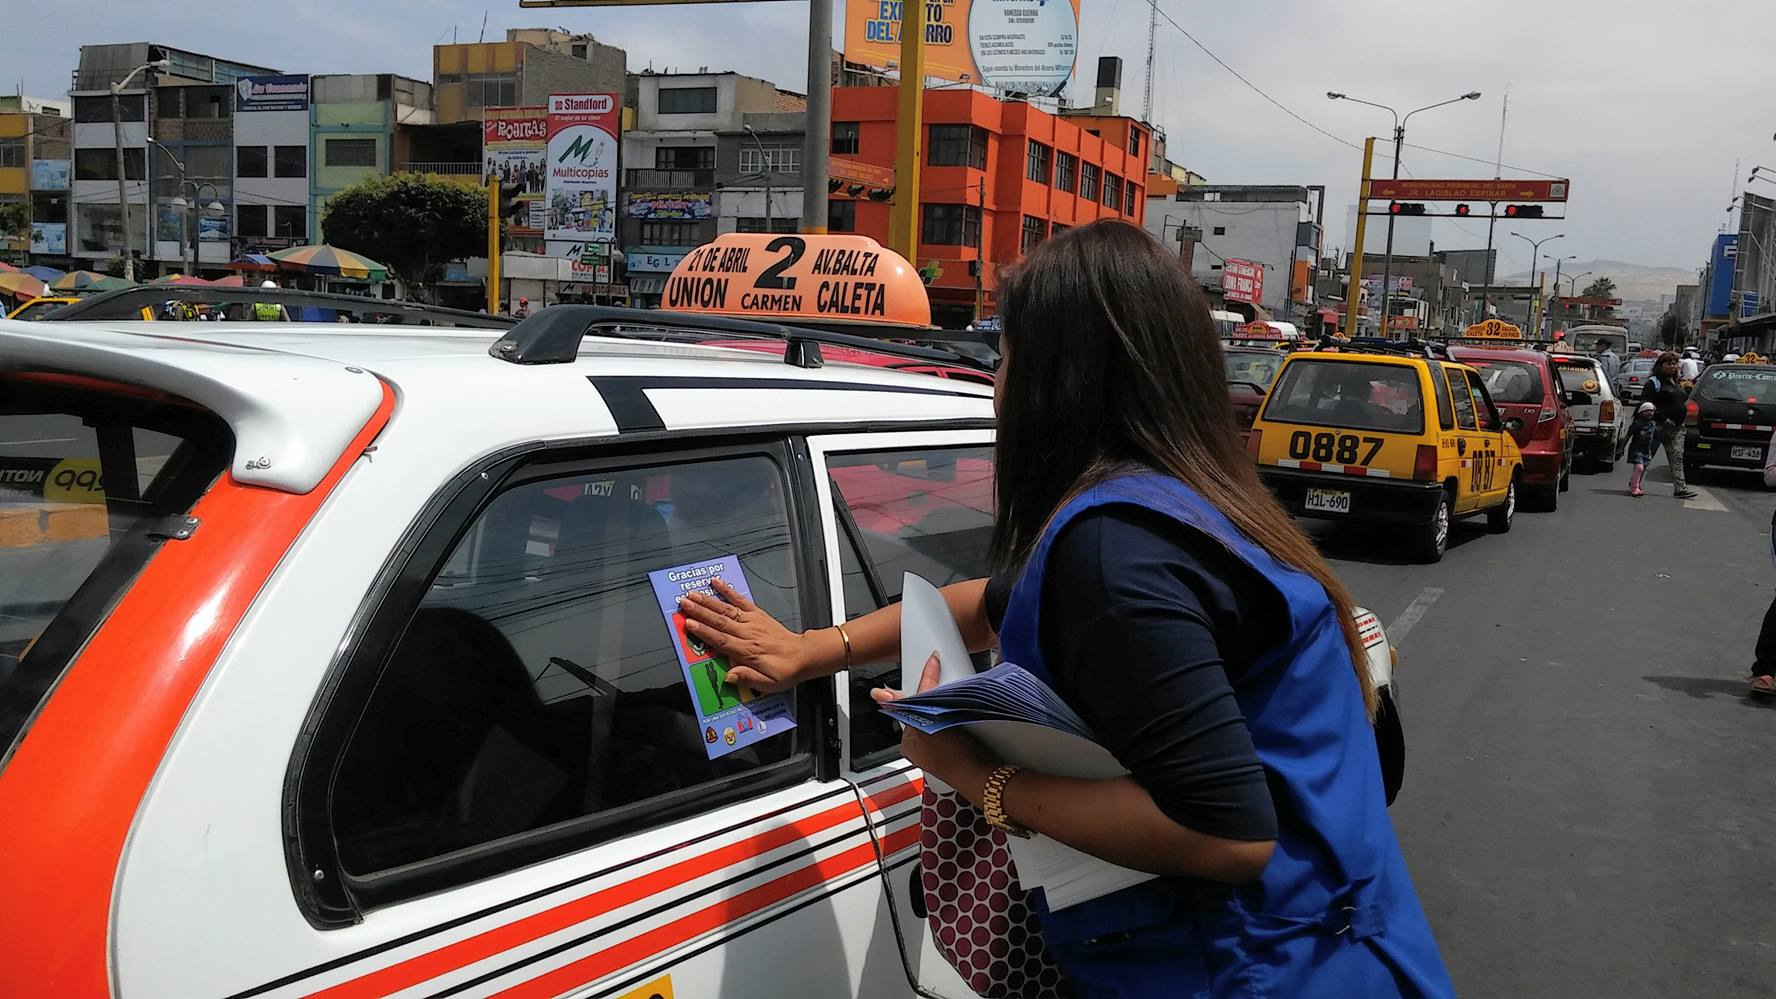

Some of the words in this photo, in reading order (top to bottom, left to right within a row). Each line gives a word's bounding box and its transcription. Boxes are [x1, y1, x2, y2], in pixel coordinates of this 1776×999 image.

[867, 20, 893, 42] DEL
[564, 98, 607, 111] Standford
[497, 120, 547, 139] ROJITAS
[552, 167, 609, 180] Multicopias
[1424, 190, 1465, 198] LADISLAO
[1469, 190, 1506, 198] ESPINAR
[702, 247, 720, 273] DE
[717, 248, 751, 273] ABRIL
[753, 237, 806, 290] 2
[669, 277, 728, 309] UNION
[741, 293, 802, 313] CARMEN
[817, 281, 885, 317] CALETA
[1486, 322, 1500, 337] 32
[1745, 354, 1756, 364] 32
[1290, 432, 1384, 467] 0887
[1307, 494, 1348, 510] H1L-690
[668, 567, 707, 582] Gracias
[708, 562, 724, 575] por
